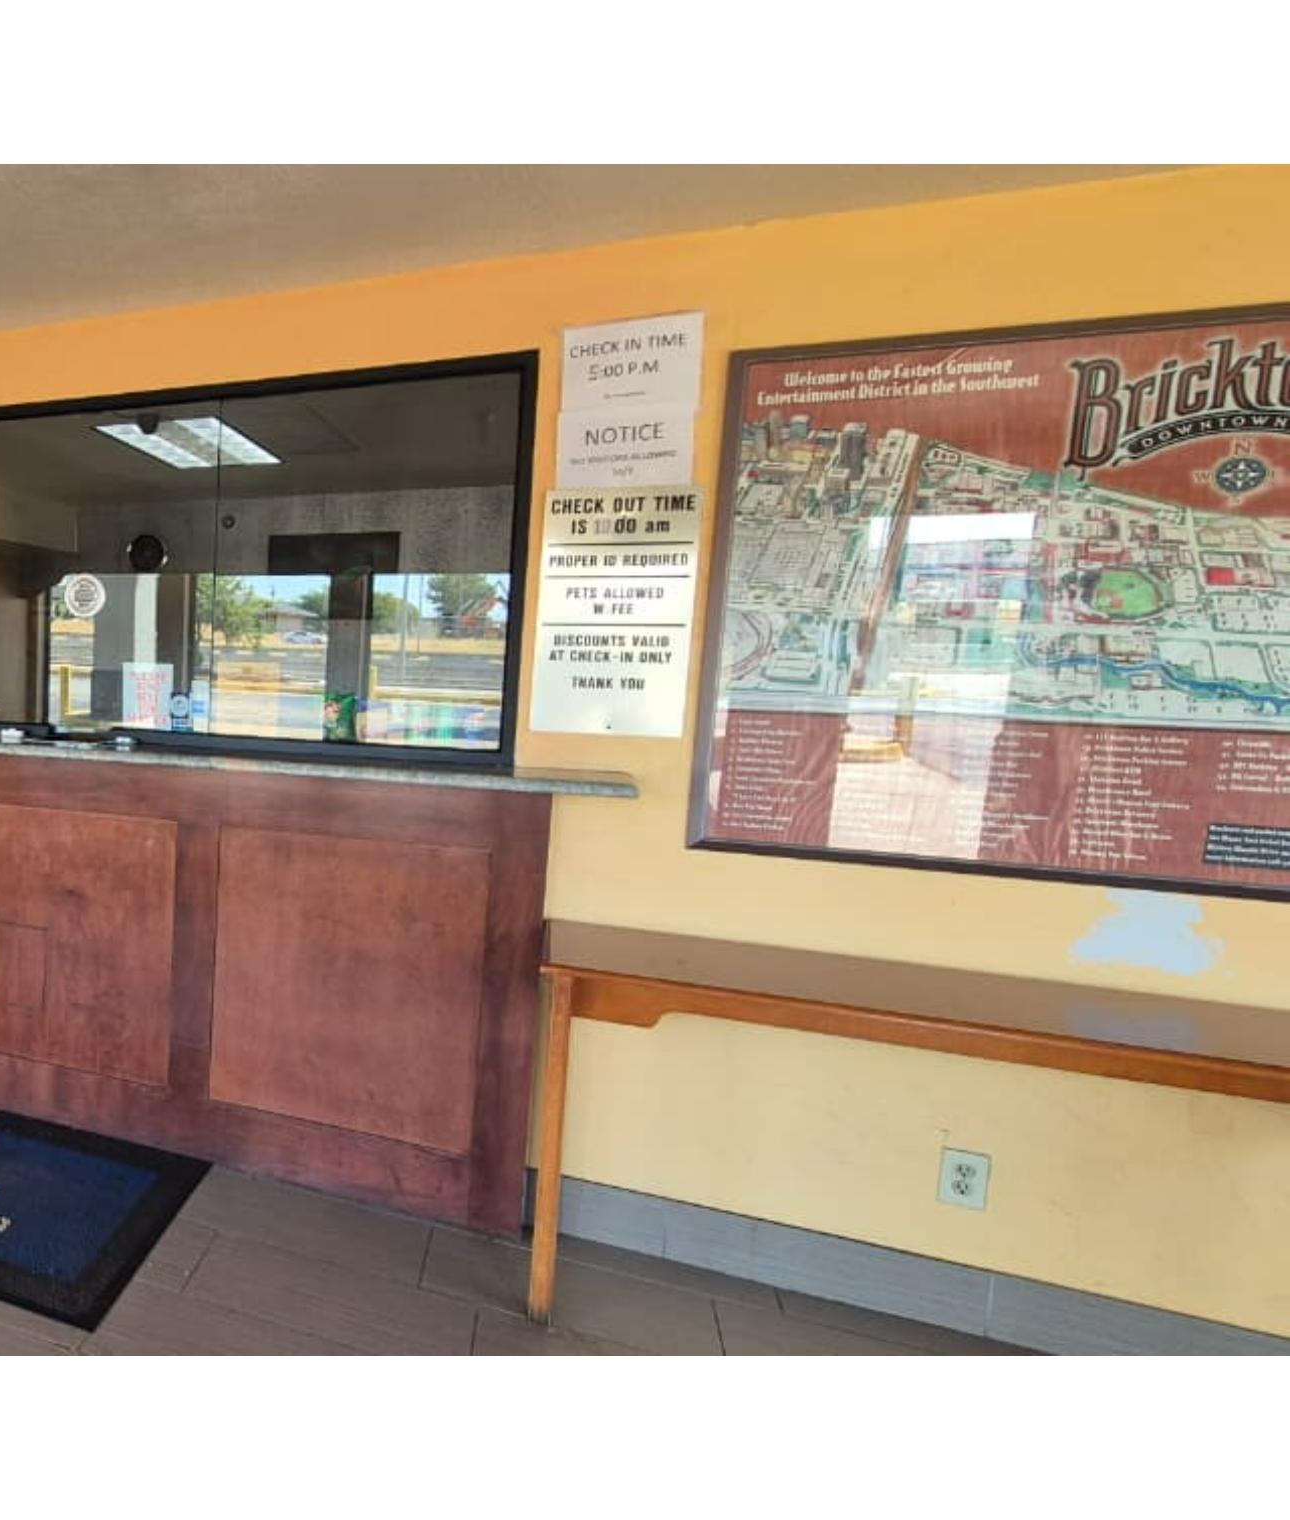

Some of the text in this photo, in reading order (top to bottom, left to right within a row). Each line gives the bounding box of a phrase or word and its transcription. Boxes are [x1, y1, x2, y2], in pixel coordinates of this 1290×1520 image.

[570, 333, 689, 359] CHECK IN TIME
[784, 357, 1013, 387] Welcome to the Fastest Growing
[757, 374, 1040, 406] Entertainment District in the Southwest
[585, 422, 666, 446] NOTICE
[1140, 413, 1289, 448] DOWNTOWN
[551, 494, 697, 515] CHECK OUT TIME
[572, 519, 588, 535] IS
[645, 520, 670, 533] am
[549, 553, 689, 568] PROPER ID REQUIRED
[566, 587, 665, 600] PETS ALLOWED
[612, 603, 634, 615] FEE
[554, 635, 670, 647] DISCOUNTS VALID
[549, 650, 672, 664] AT CHECK-IN ONLY
[572, 677, 646, 690] THANK YOU
